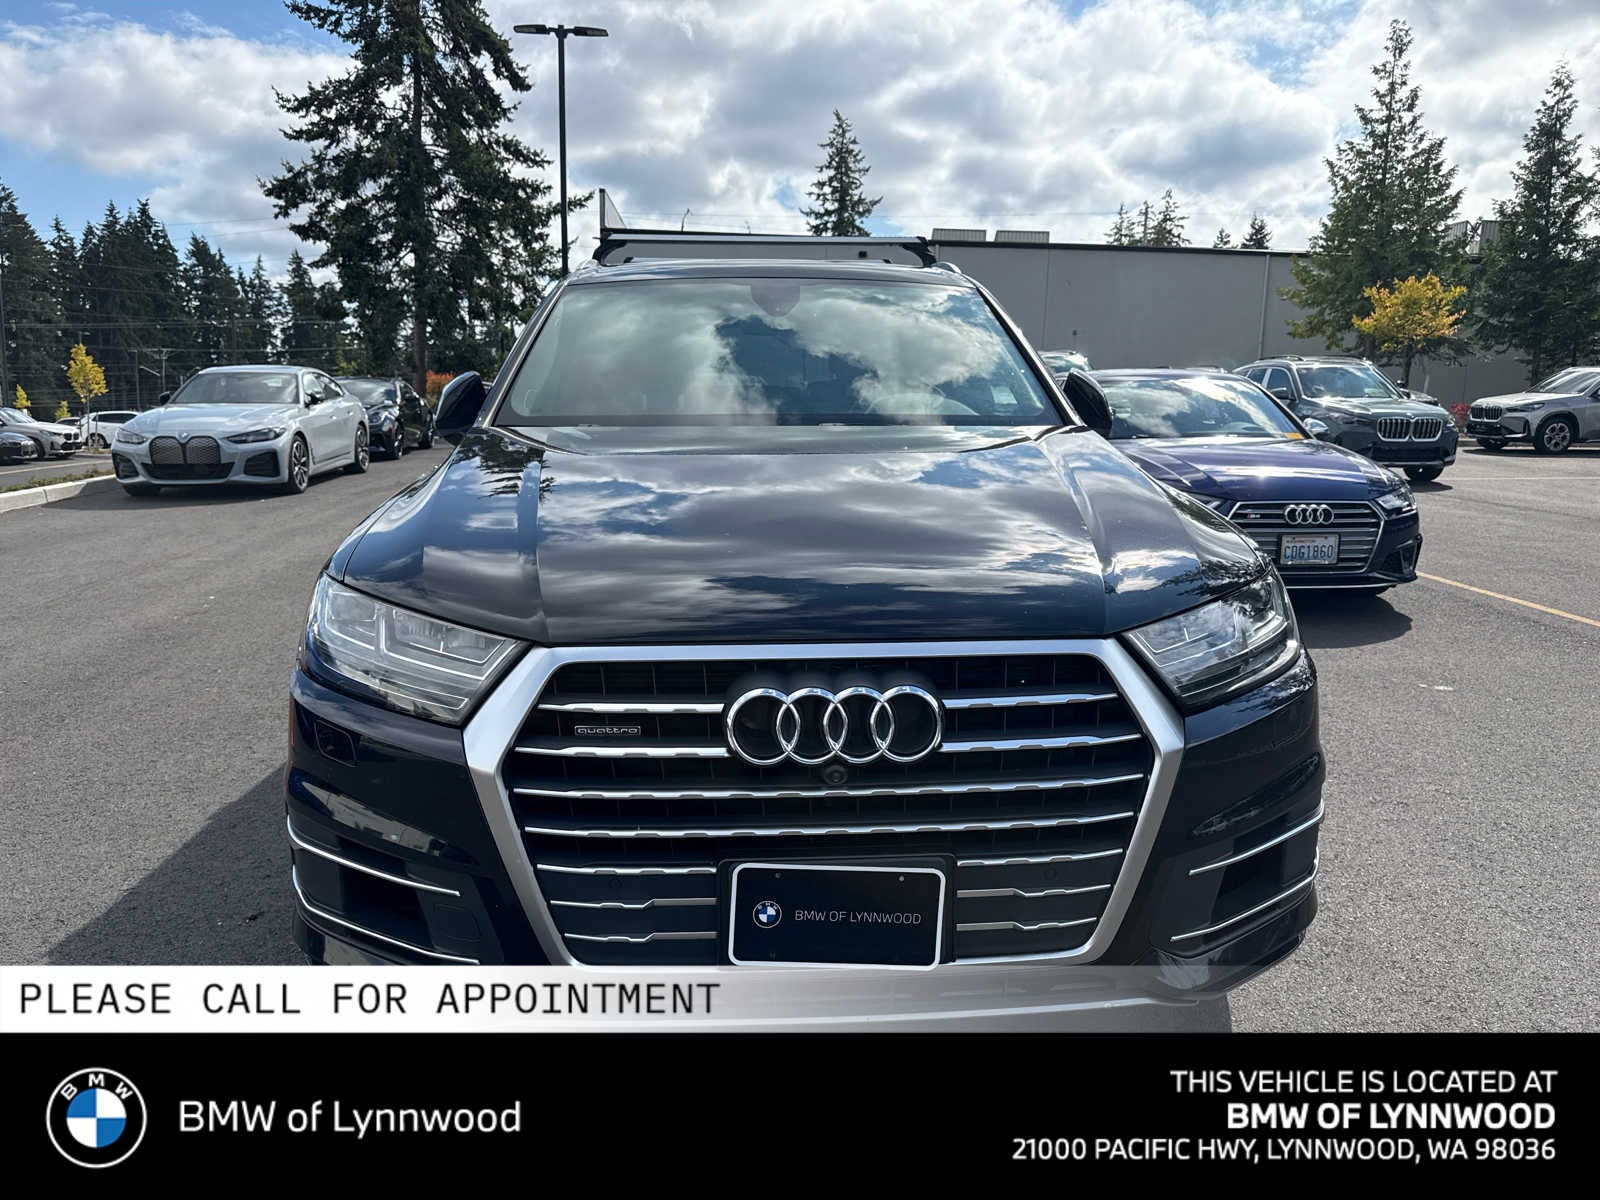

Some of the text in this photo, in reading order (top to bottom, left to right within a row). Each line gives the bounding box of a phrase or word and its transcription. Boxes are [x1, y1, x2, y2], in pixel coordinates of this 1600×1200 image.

[577, 727, 638, 735] quattro
[794, 910, 922, 925] BMW OF LYNNWOOD
